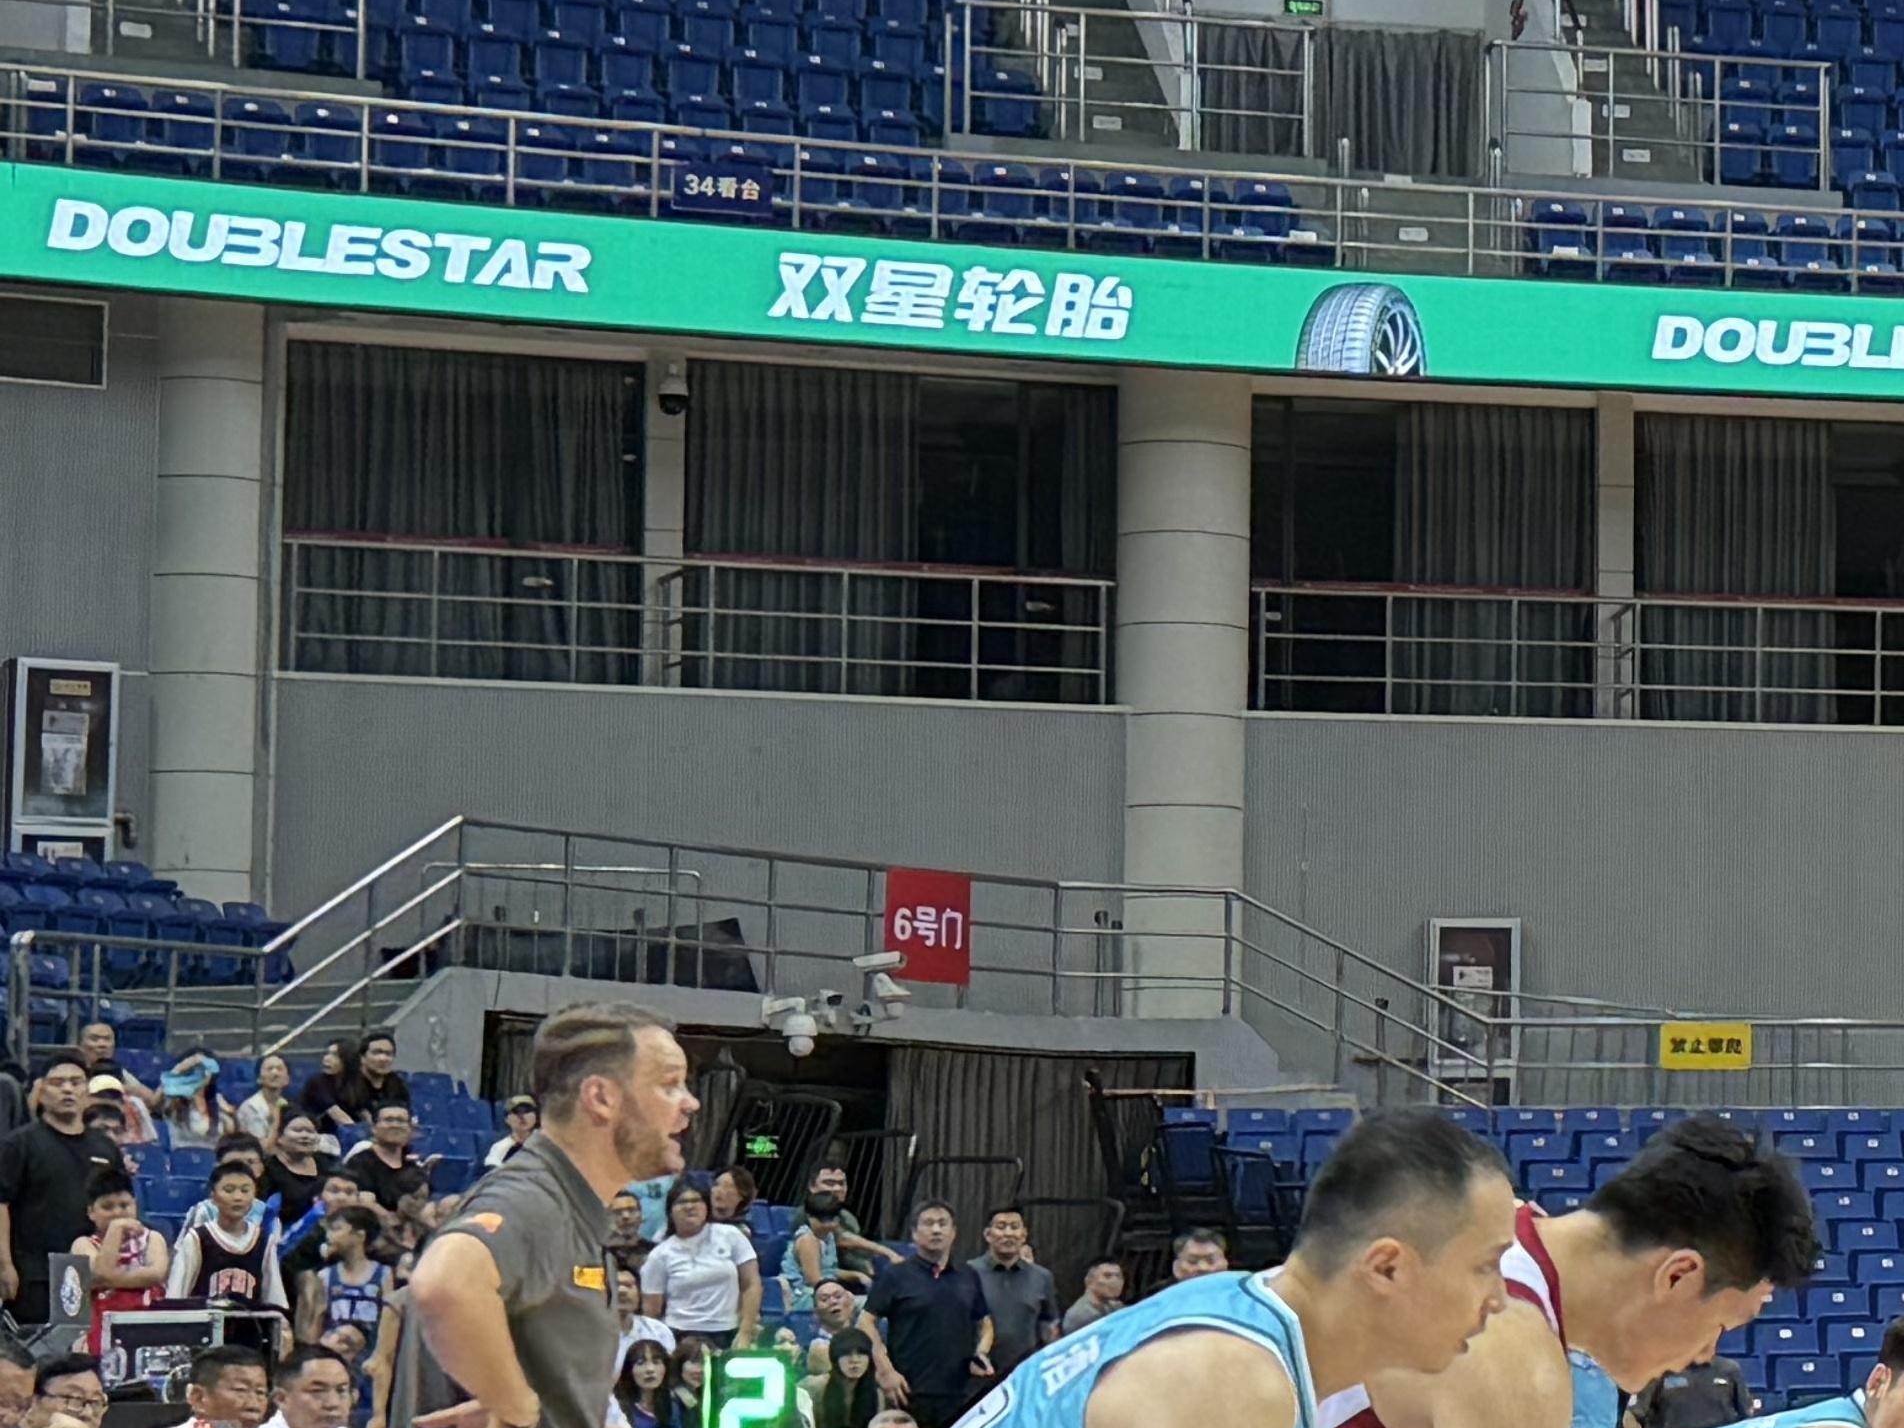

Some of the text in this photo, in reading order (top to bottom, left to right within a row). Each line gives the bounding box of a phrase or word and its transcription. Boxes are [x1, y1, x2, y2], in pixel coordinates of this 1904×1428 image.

[46, 197, 591, 294] DOUBLESTAR
[767, 252, 1133, 340] 双星轮胎
[893, 905, 963, 950] 6号门
